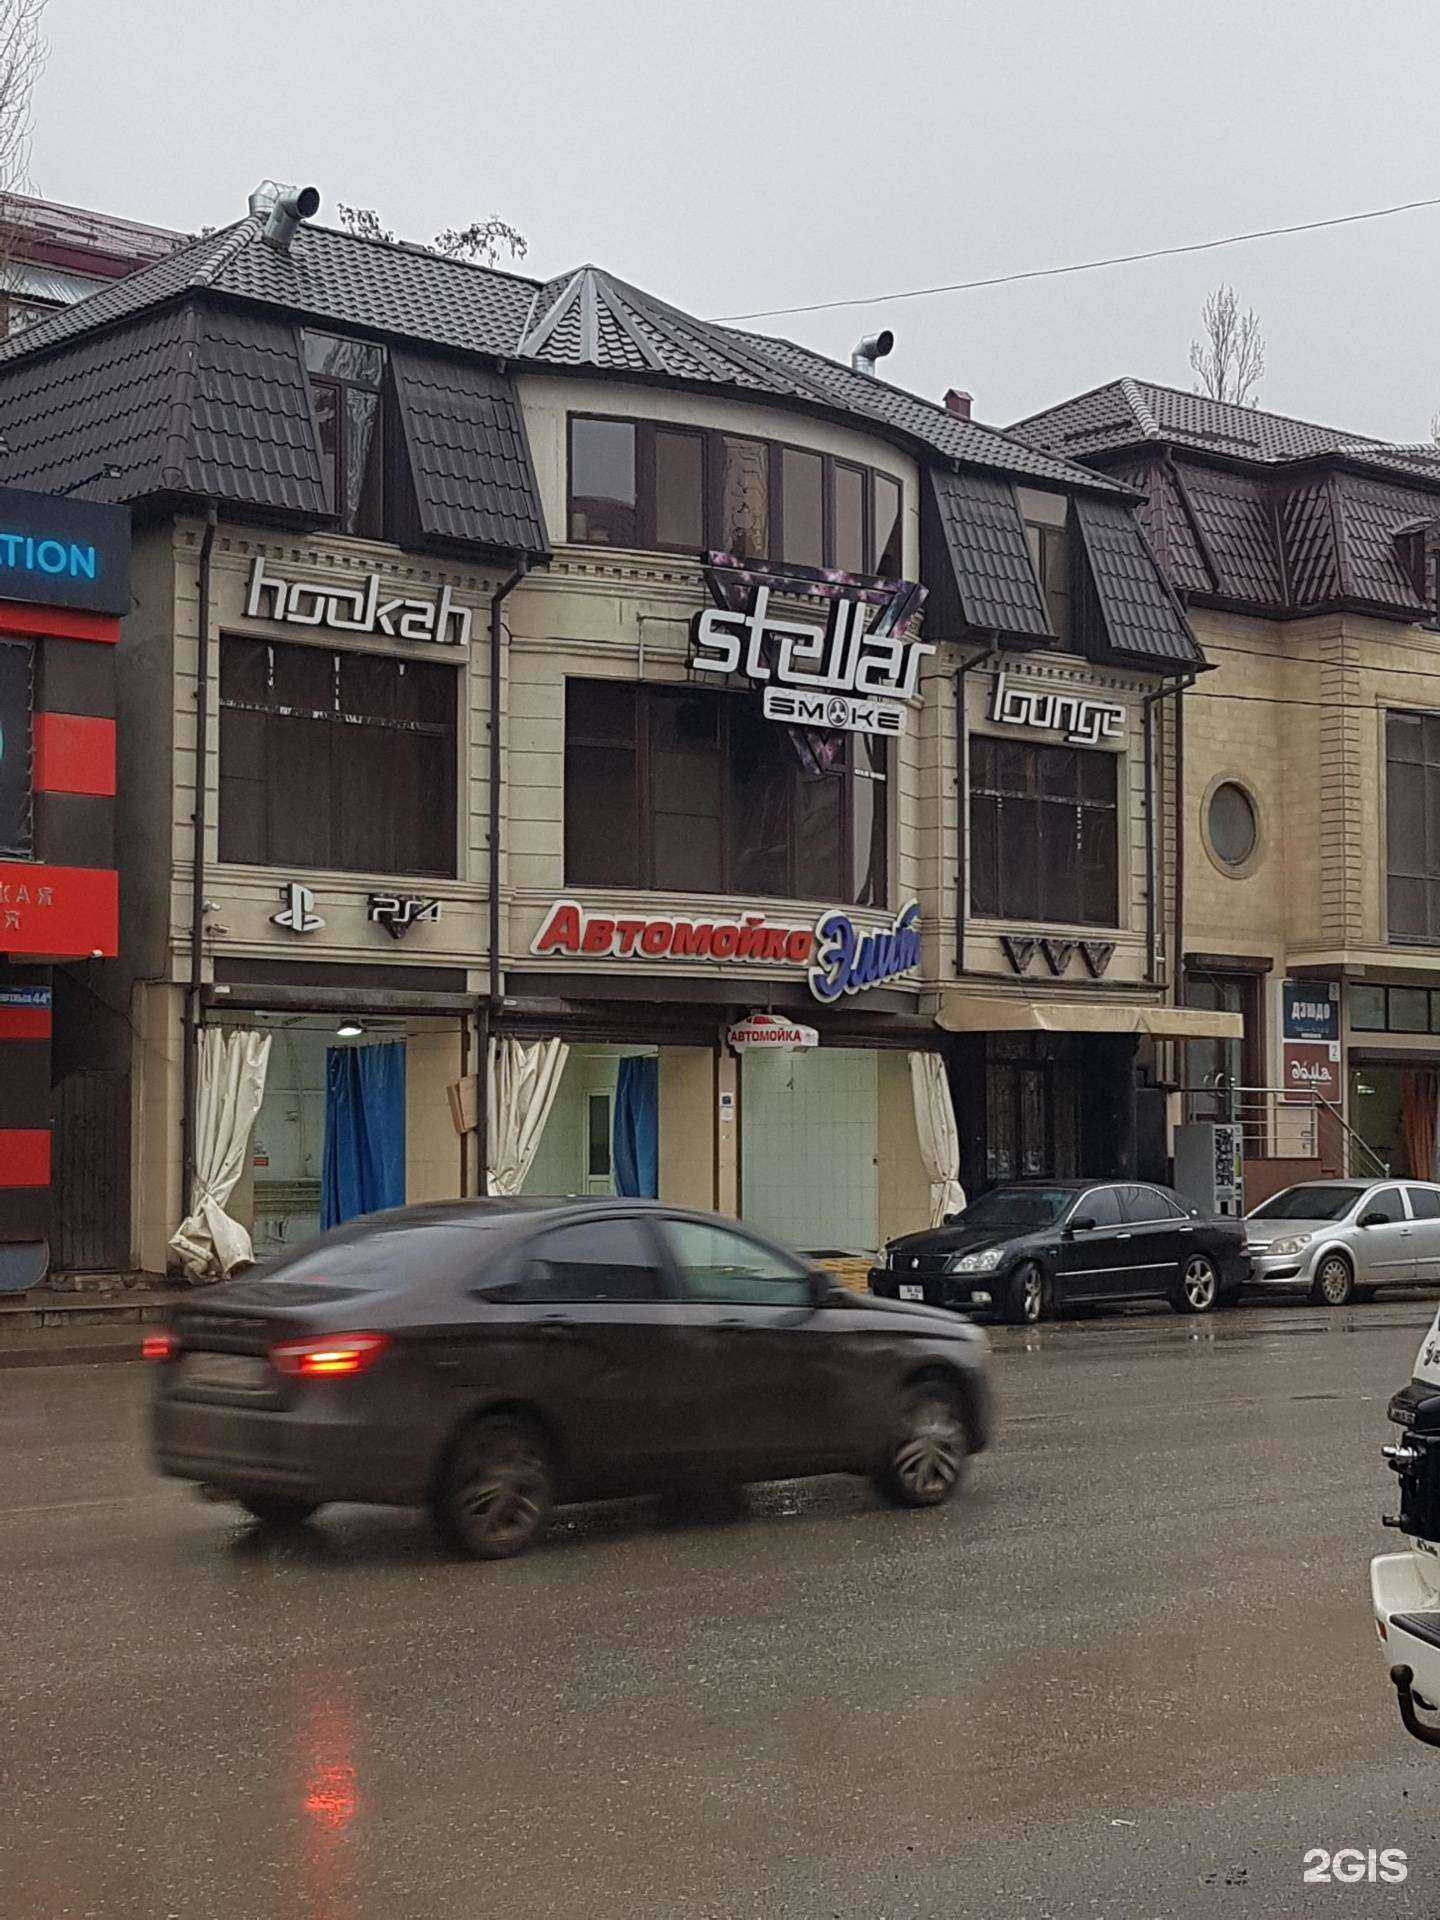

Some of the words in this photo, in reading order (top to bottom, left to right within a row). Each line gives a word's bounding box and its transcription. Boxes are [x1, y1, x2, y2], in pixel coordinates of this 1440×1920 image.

[0, 533, 96, 579] TION
[247, 556, 473, 645] hookah
[693, 586, 937, 699] stellar
[769, 696, 900, 731] SMOKE
[993, 671, 1127, 744] lounge
[372, 897, 442, 922] PS4
[730, 1028, 802, 1042] АВТОМОЙКА
